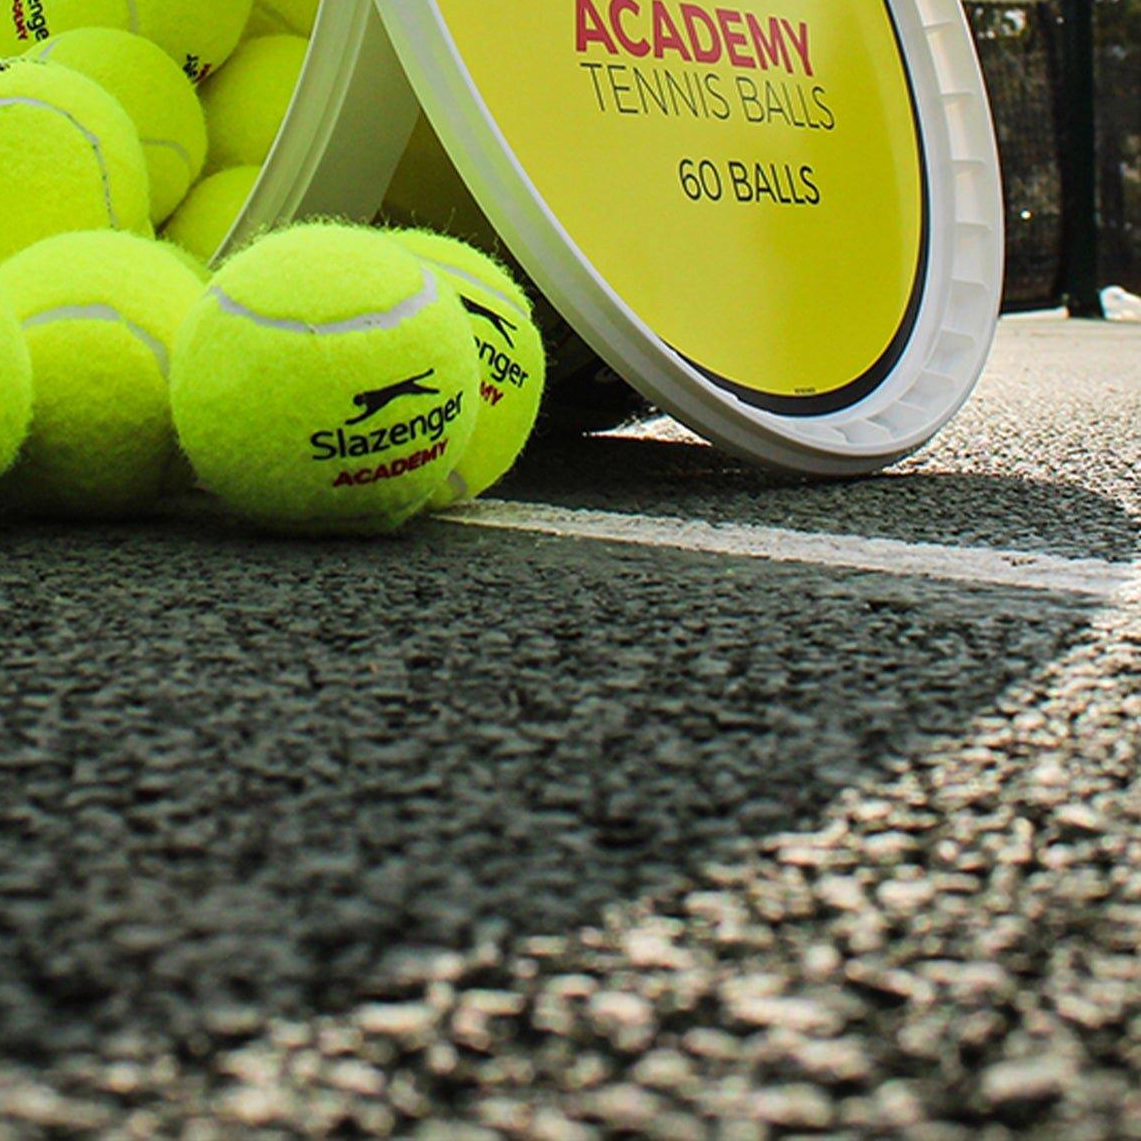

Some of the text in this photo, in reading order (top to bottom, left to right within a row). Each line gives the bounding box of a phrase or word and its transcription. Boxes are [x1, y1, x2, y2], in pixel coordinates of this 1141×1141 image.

[579, 61, 836, 132] TENNIS BALLS
[678, 159, 821, 205] 60 BALLS
[310, 391, 464, 460] Slazenger
[332, 438, 449, 488] ACADEMY
